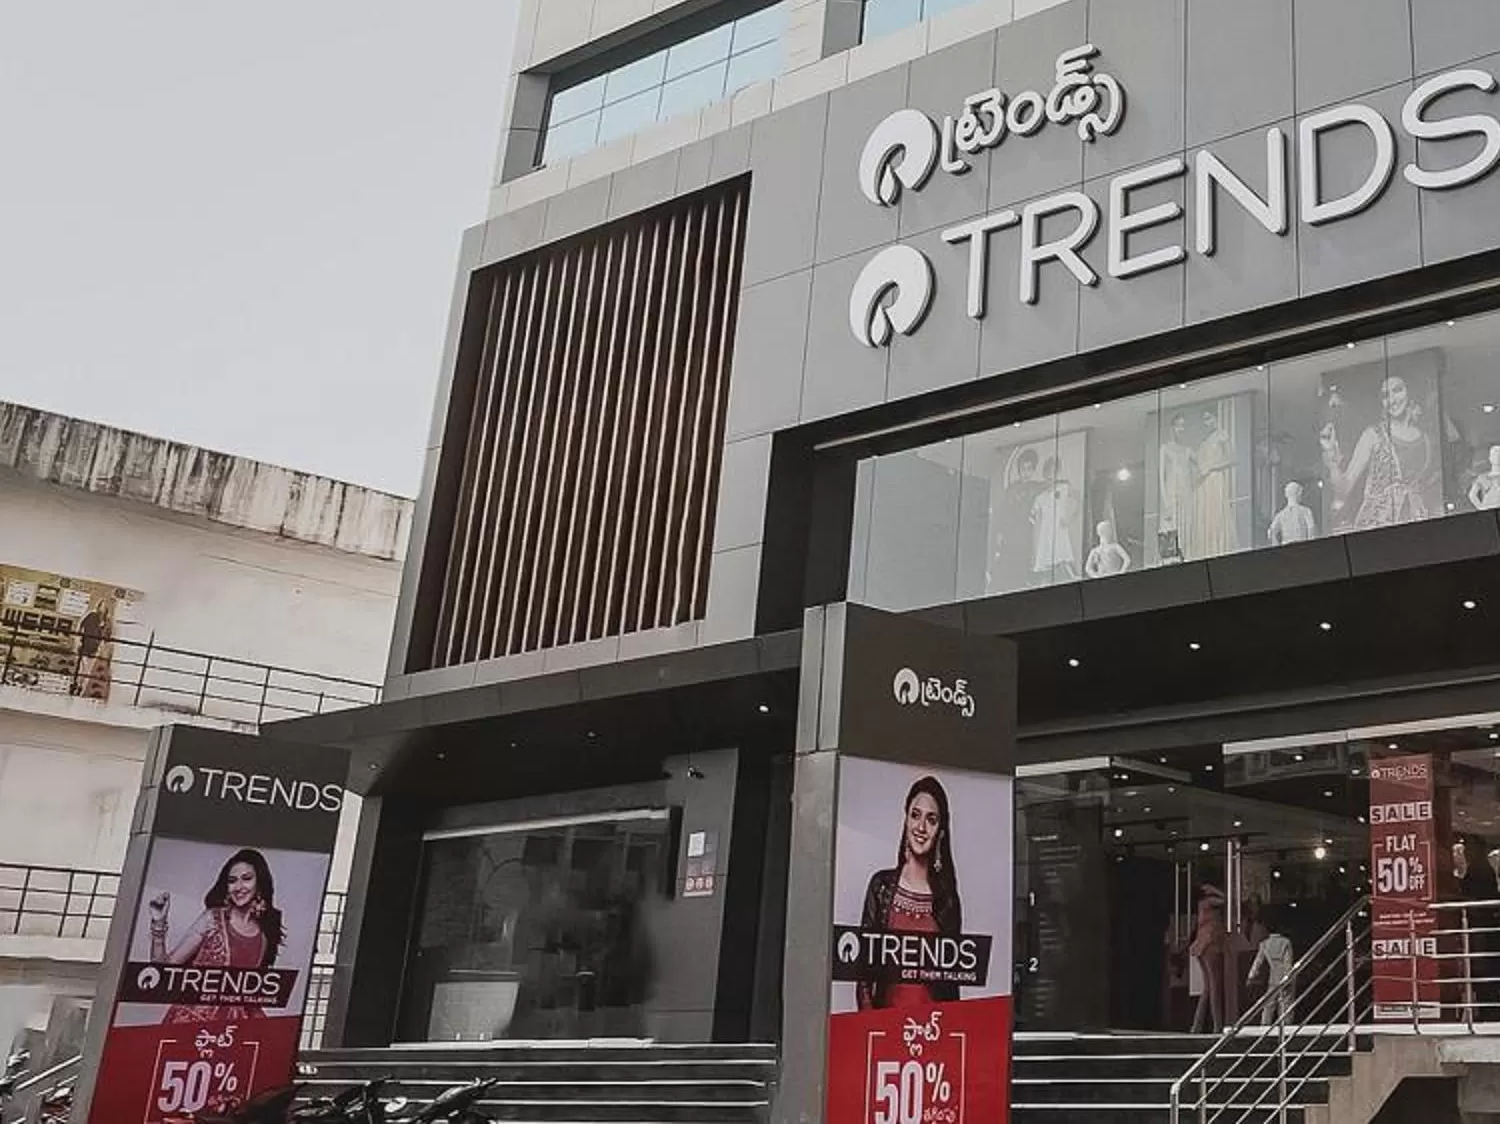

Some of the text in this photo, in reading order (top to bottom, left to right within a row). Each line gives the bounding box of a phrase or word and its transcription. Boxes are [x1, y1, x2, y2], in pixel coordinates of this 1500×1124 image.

[1380, 764, 1426, 778] TRENDS
[199, 767, 343, 812] TRENDS
[1371, 803, 1429, 822] SALE
[1386, 834, 1416, 852] FLAT
[1378, 857, 1423, 893] 50%
[1409, 875, 1424, 891] OFF
[862, 933, 977, 969] TRENDS
[1029, 957, 1039, 972] 2
[163, 967, 281, 996] TRENDS
[902, 969, 977, 982] GET THEM TALKING
[200, 994, 217, 1003] GET
[220, 995, 240, 1004] THEM
[157, 1061, 238, 1113] 50%
[874, 1060, 951, 1124] 50%
